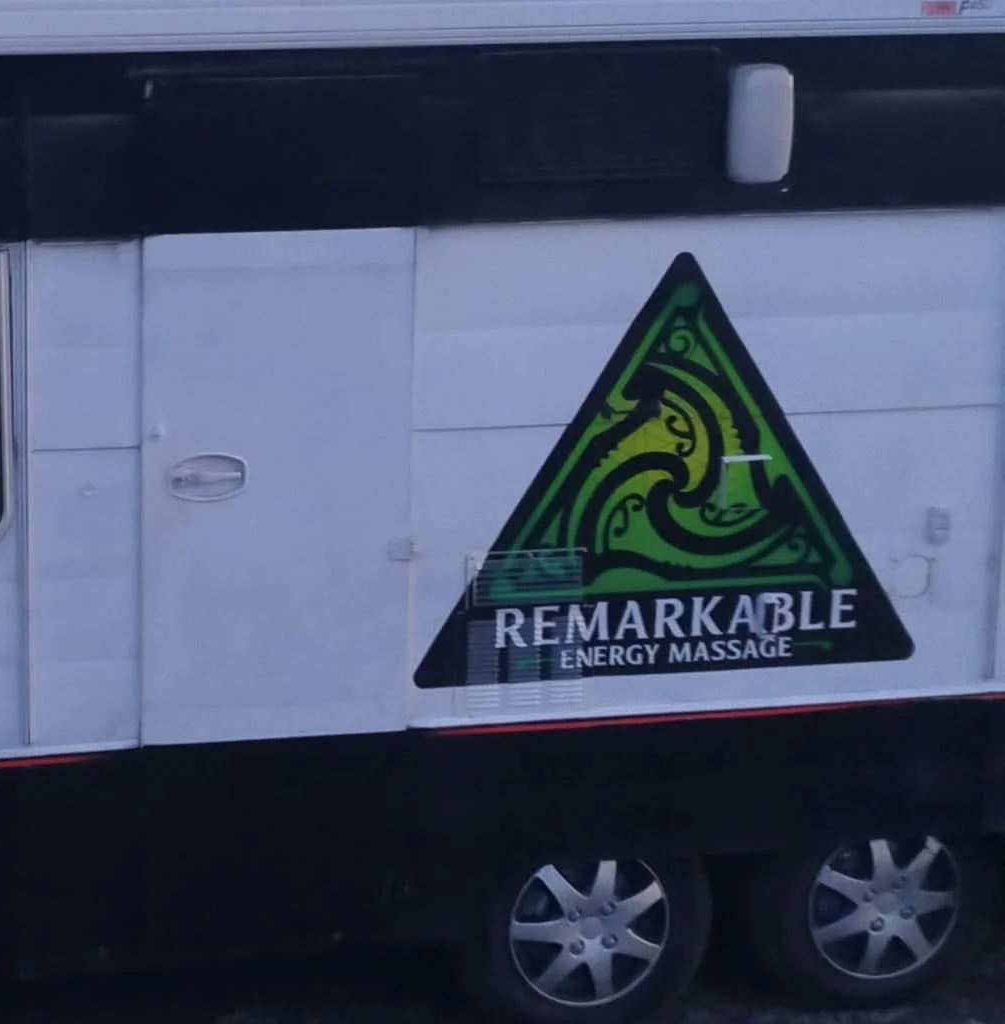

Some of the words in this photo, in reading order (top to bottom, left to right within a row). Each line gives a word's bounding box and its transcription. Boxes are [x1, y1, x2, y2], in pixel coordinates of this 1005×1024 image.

[495, 588, 858, 649] REMARKABLE
[561, 643, 659, 670] ENERGY
[669, 636, 792, 665] MASSAGE
